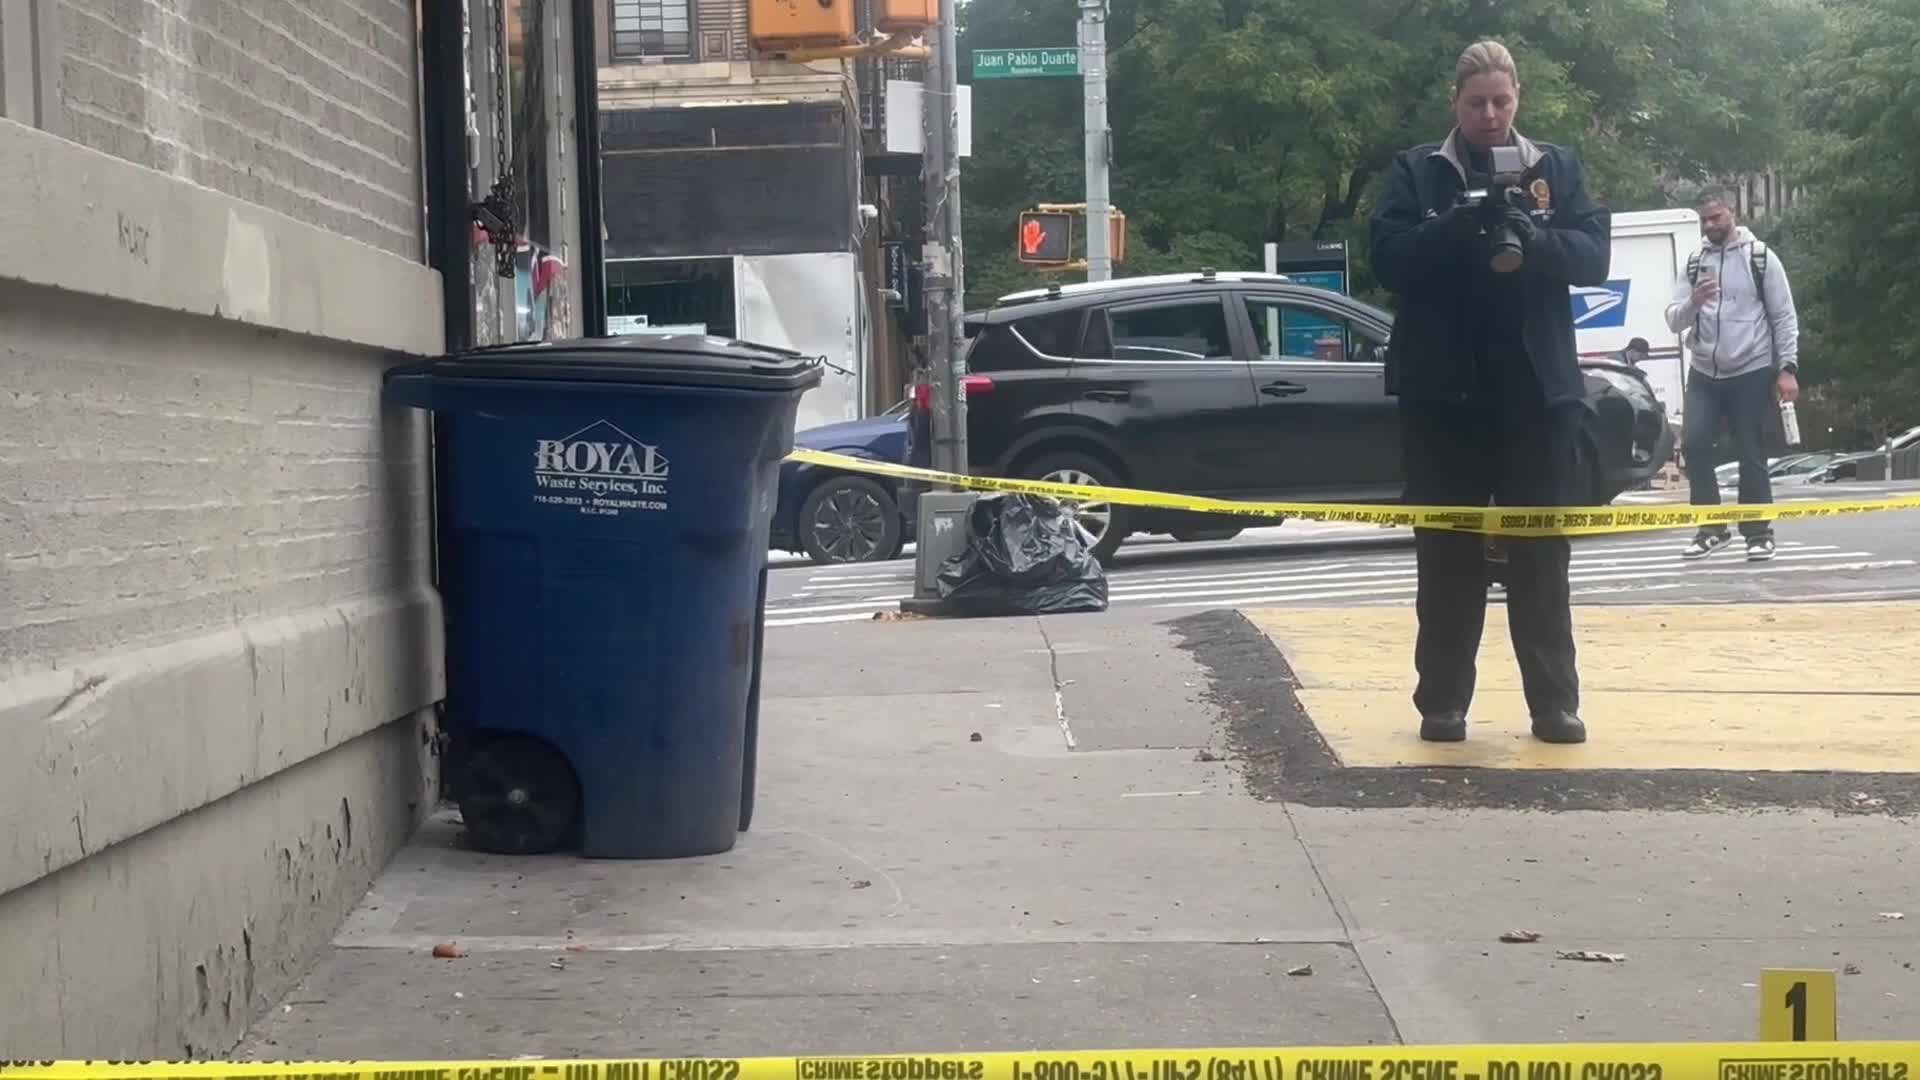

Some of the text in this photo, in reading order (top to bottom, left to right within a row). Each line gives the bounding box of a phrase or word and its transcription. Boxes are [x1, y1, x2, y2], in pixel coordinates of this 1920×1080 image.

[977, 51, 1077, 67] Juan Pablo Duarte
[536, 439, 669, 476] ROYAL
[536, 475, 668, 495] Waste Services, Inc.
[1785, 981, 1807, 1042] 1
